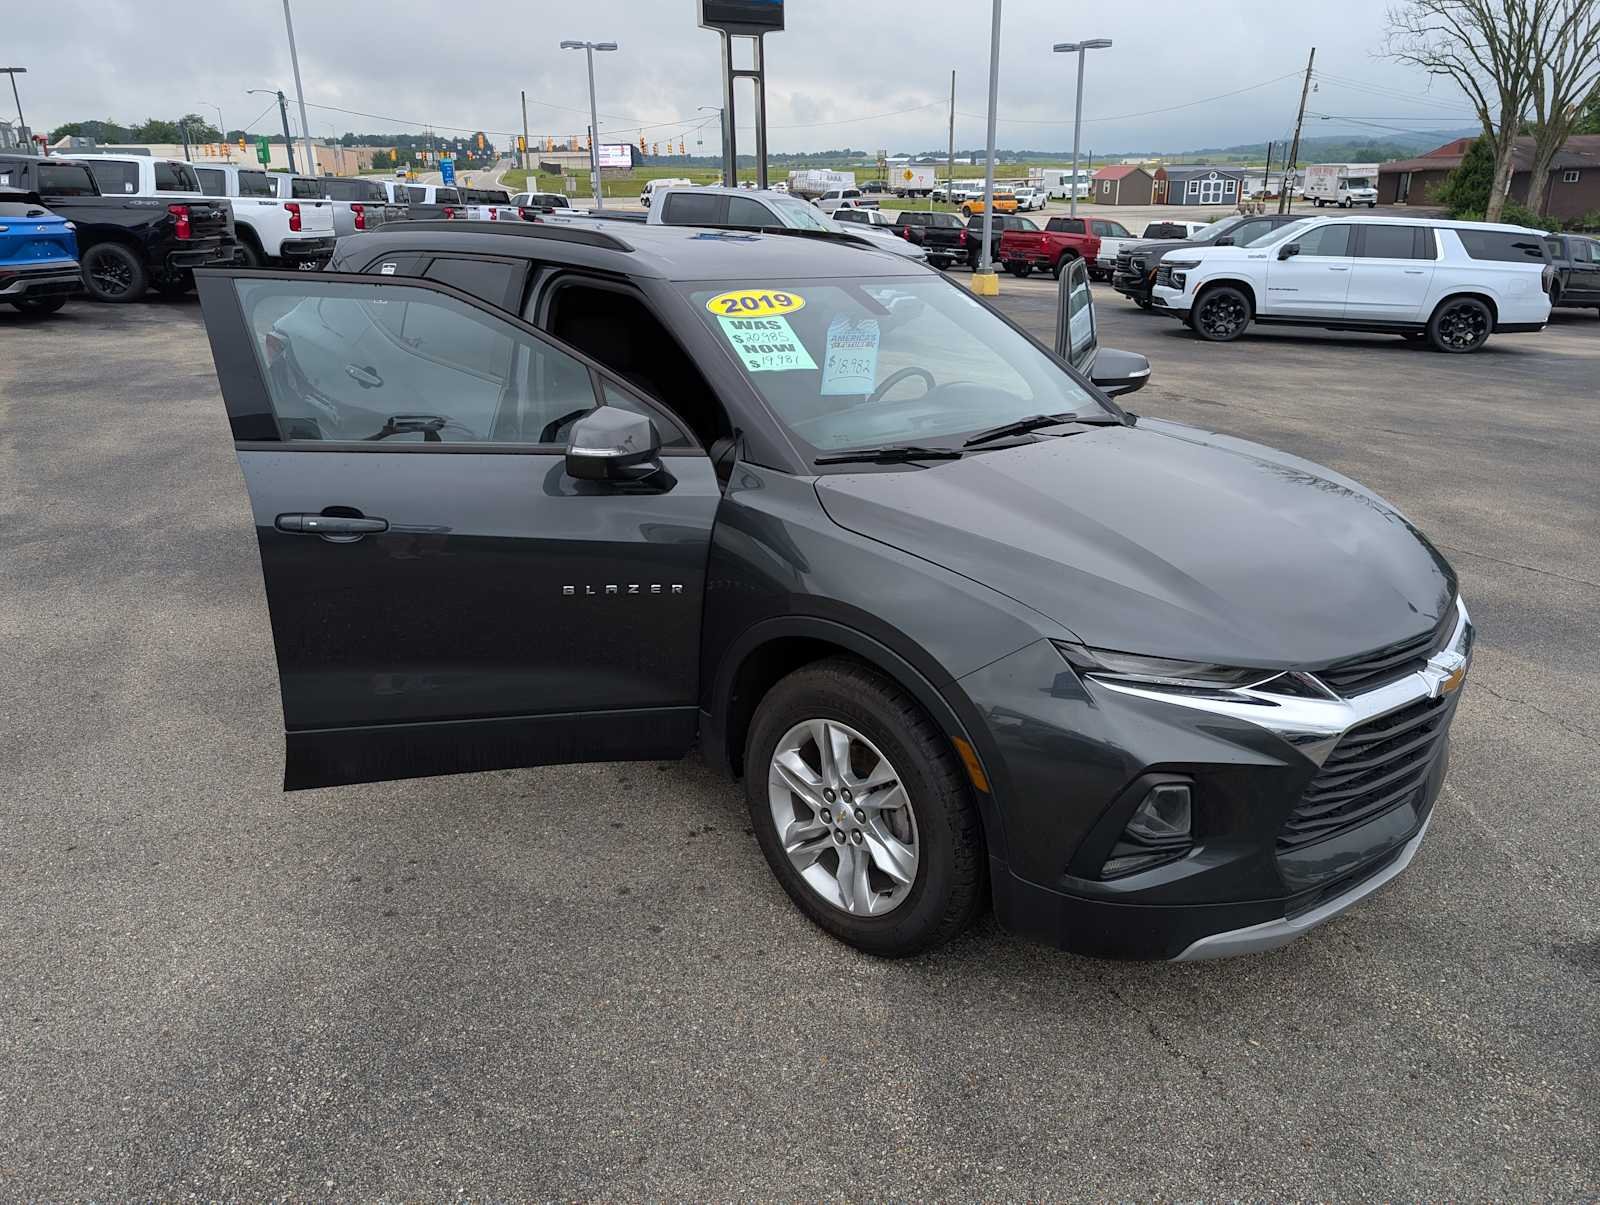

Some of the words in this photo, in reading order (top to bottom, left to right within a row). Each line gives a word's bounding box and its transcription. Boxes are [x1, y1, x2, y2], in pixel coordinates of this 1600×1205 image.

[720, 293, 793, 314] 2019
[729, 320, 782, 330] WAS
[743, 343, 796, 354] NOW
[562, 583, 684, 596] BLAZER
